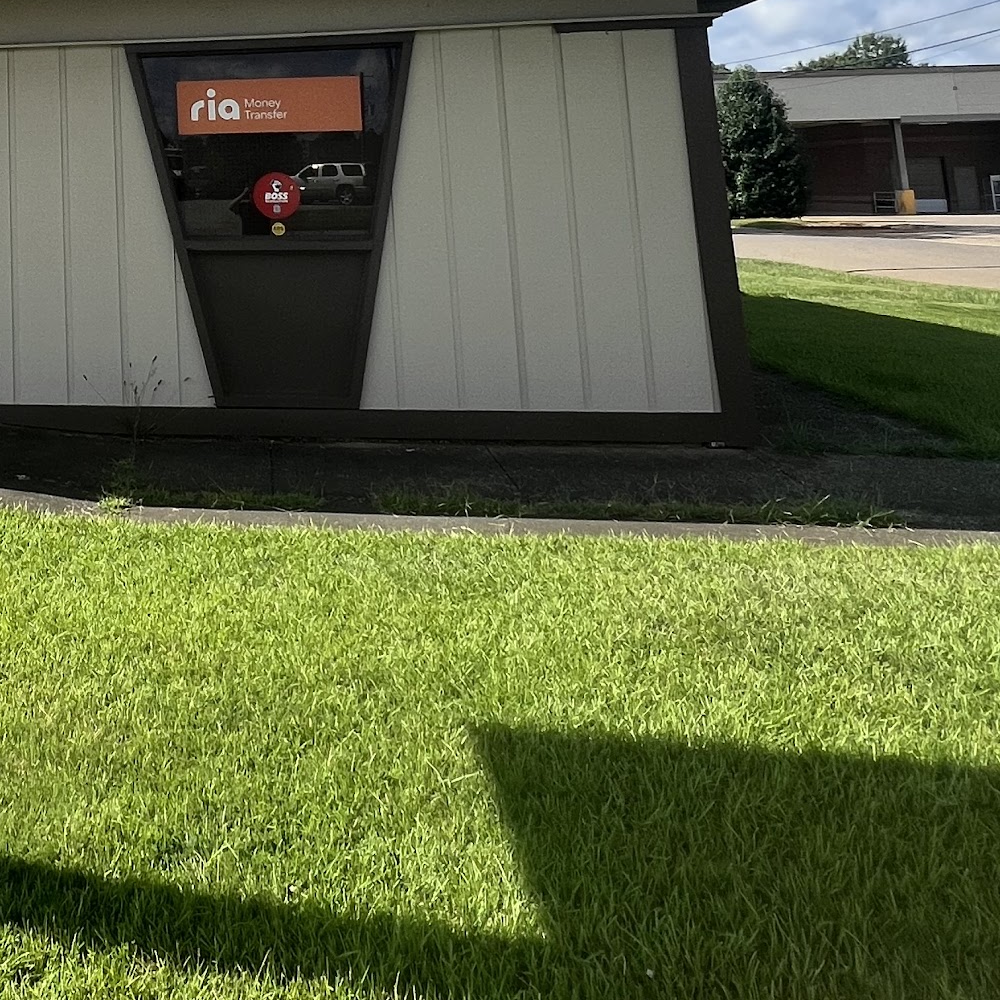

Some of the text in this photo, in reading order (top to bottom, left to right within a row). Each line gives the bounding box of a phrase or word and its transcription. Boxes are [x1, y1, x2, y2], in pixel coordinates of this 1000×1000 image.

[191, 88, 240, 121] ria
[244, 98, 281, 109] Money
[244, 110, 287, 119] Transfer
[265, 192, 288, 200] BOSS
